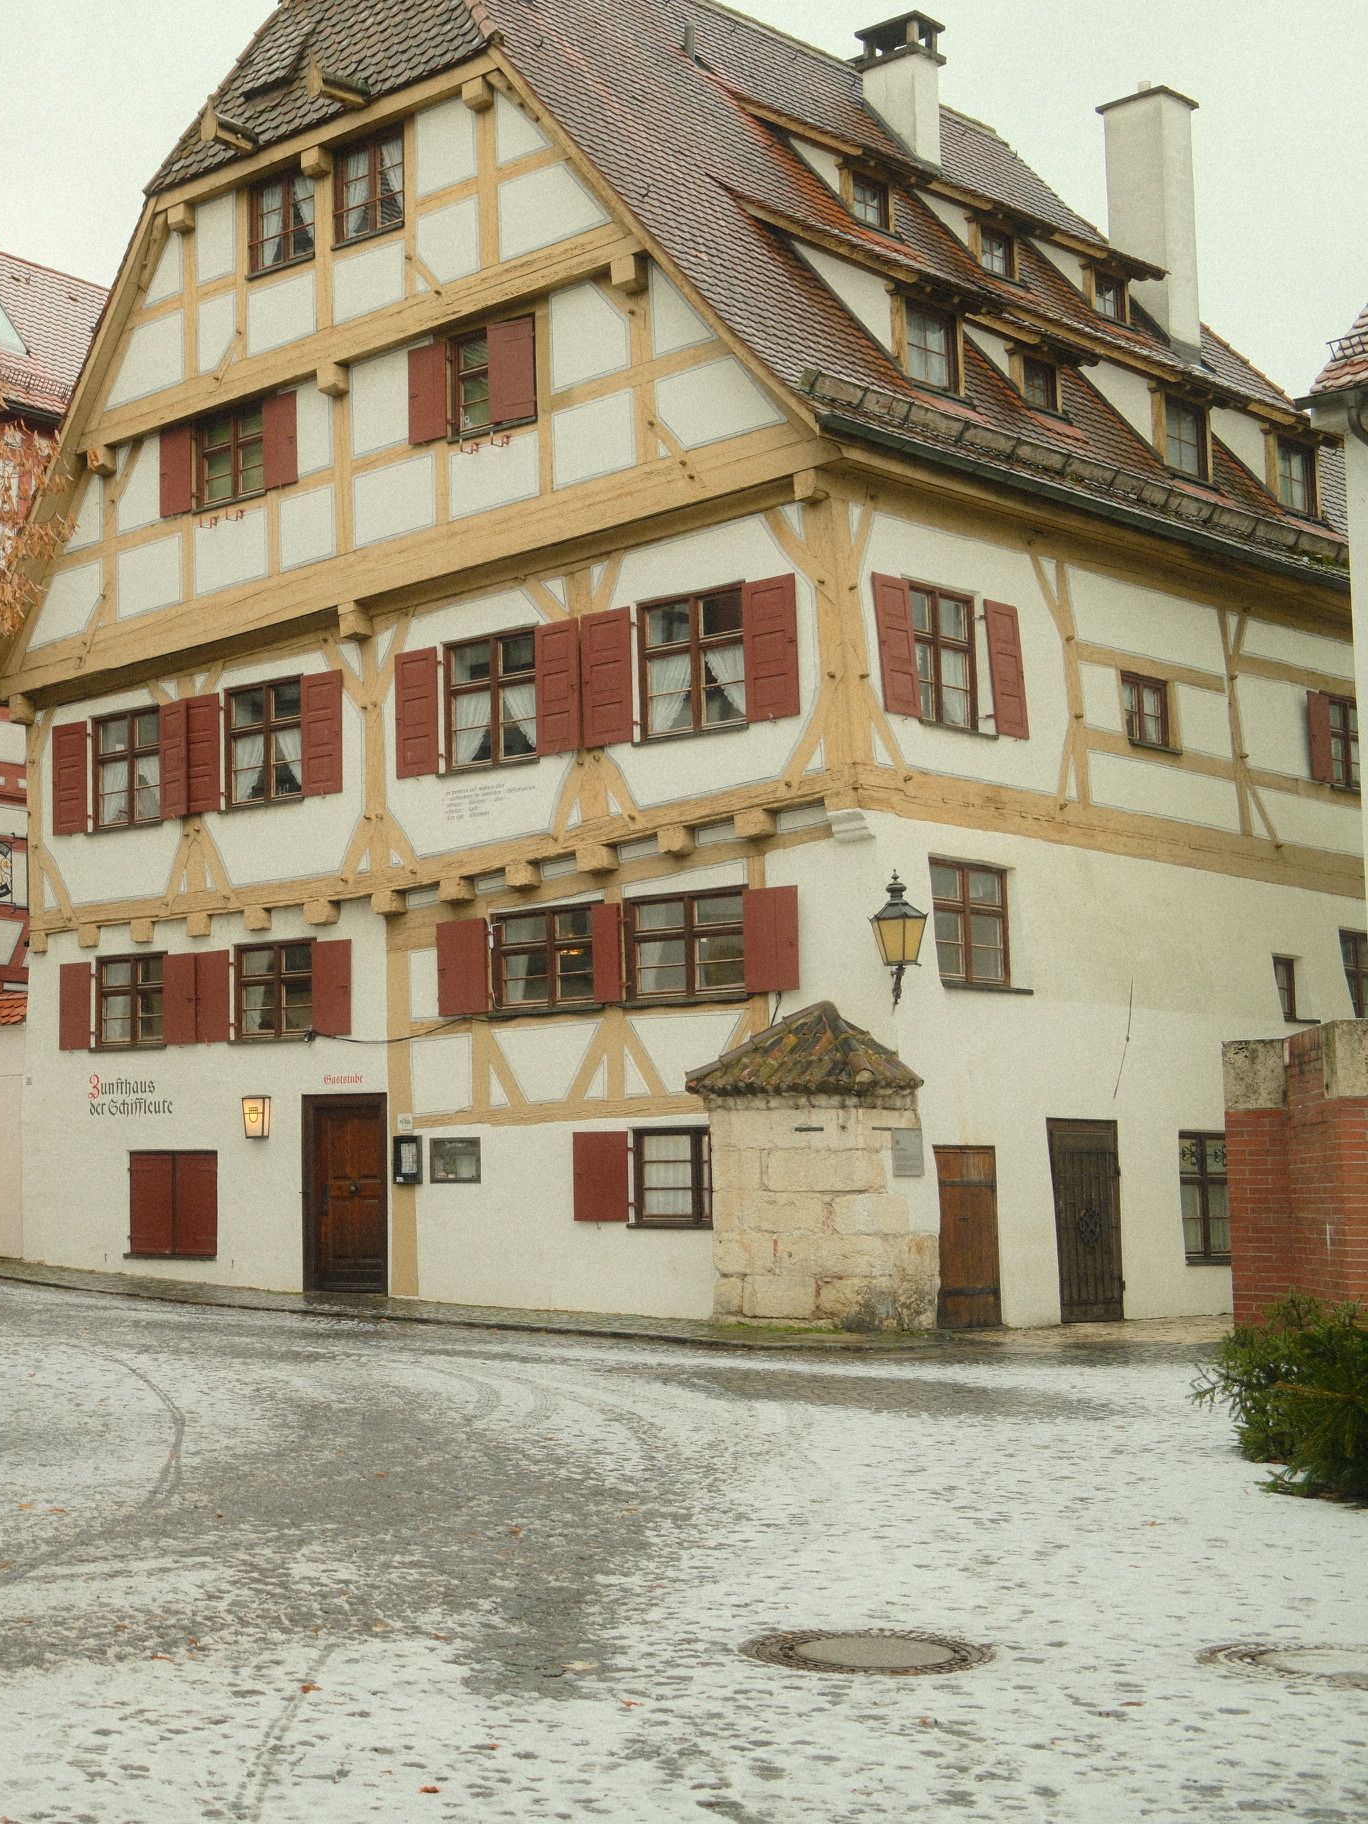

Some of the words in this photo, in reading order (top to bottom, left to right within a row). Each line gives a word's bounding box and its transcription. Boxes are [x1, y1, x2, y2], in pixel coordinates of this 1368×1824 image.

[88, 1073, 155, 1099] Zunfthaus
[323, 1073, 363, 1085] Gaststube
[89, 1099, 107, 1116] der
[108, 1097, 173, 1118] Schiffleute
